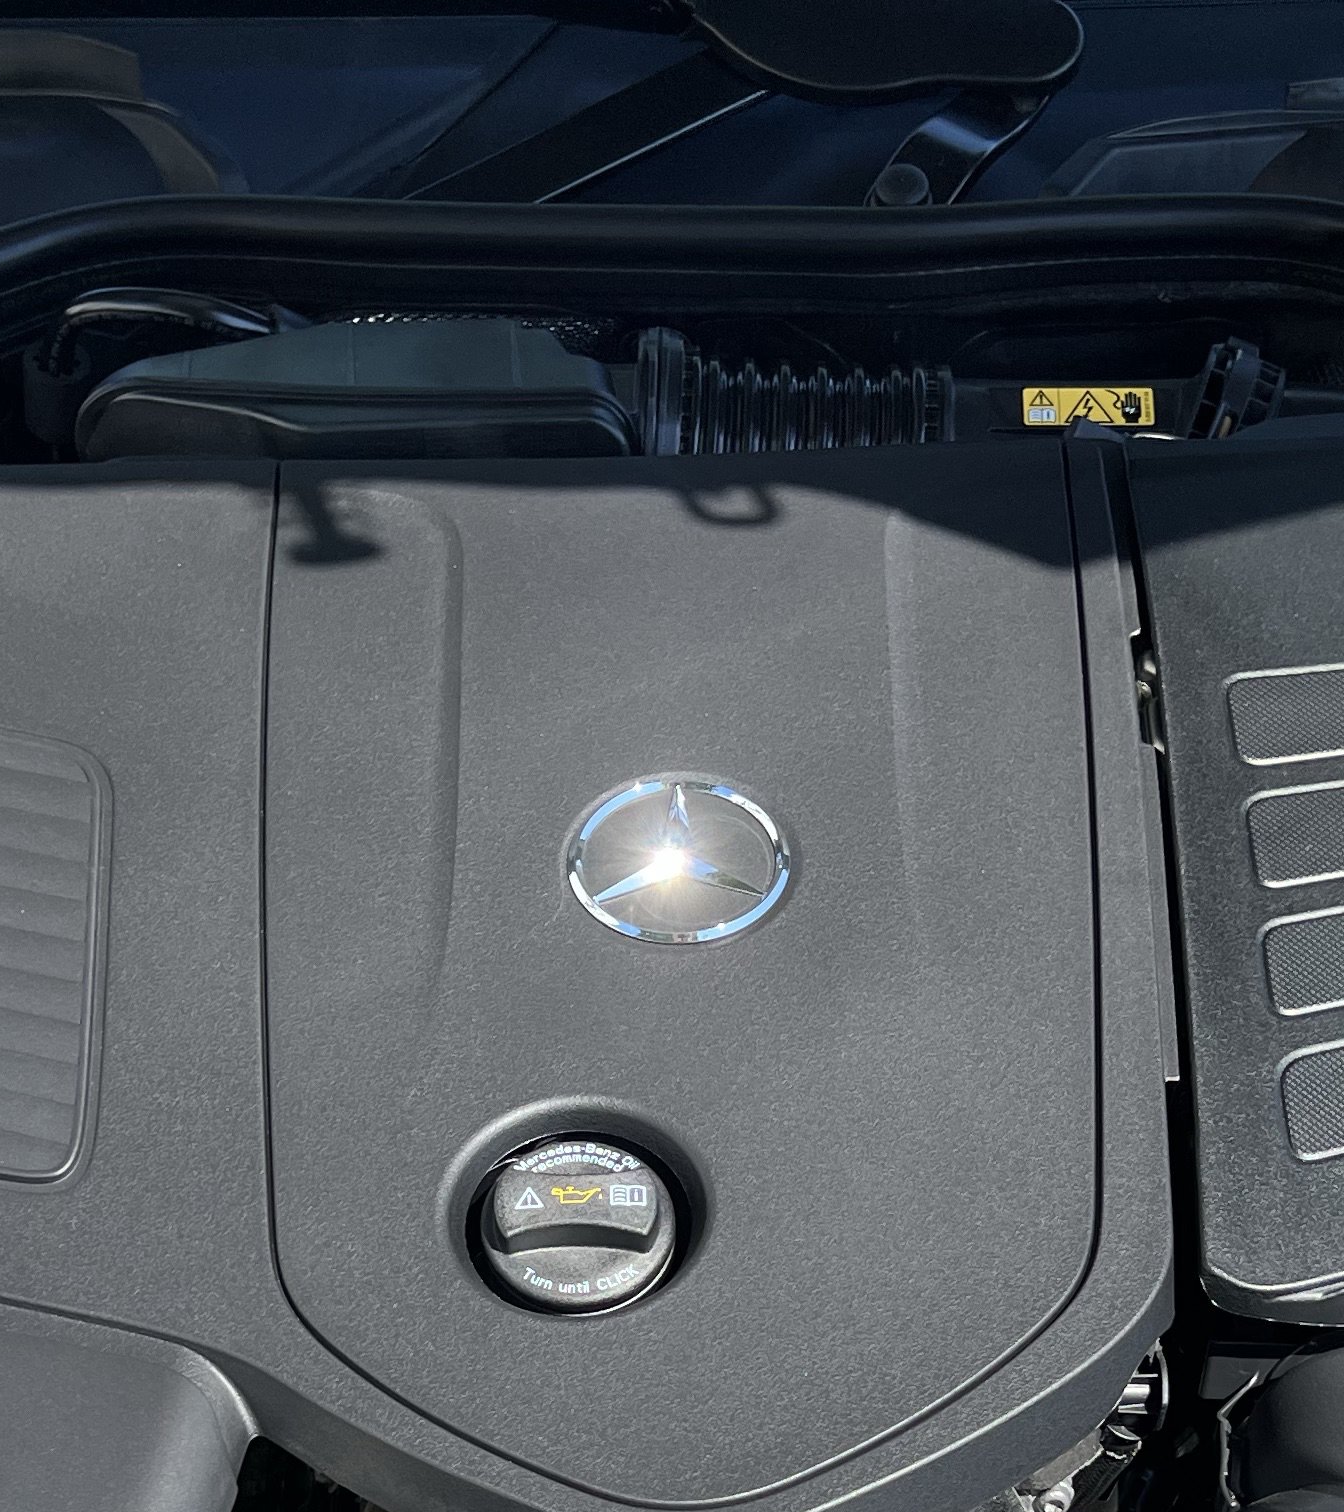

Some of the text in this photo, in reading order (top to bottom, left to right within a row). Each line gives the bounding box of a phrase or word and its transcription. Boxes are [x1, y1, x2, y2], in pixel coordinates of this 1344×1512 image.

[513, 1142, 641, 1171] Mercedes-Benz Oil
[530, 1154, 625, 1173] recommended
[523, 1263, 640, 1294] Turn until CLICK
